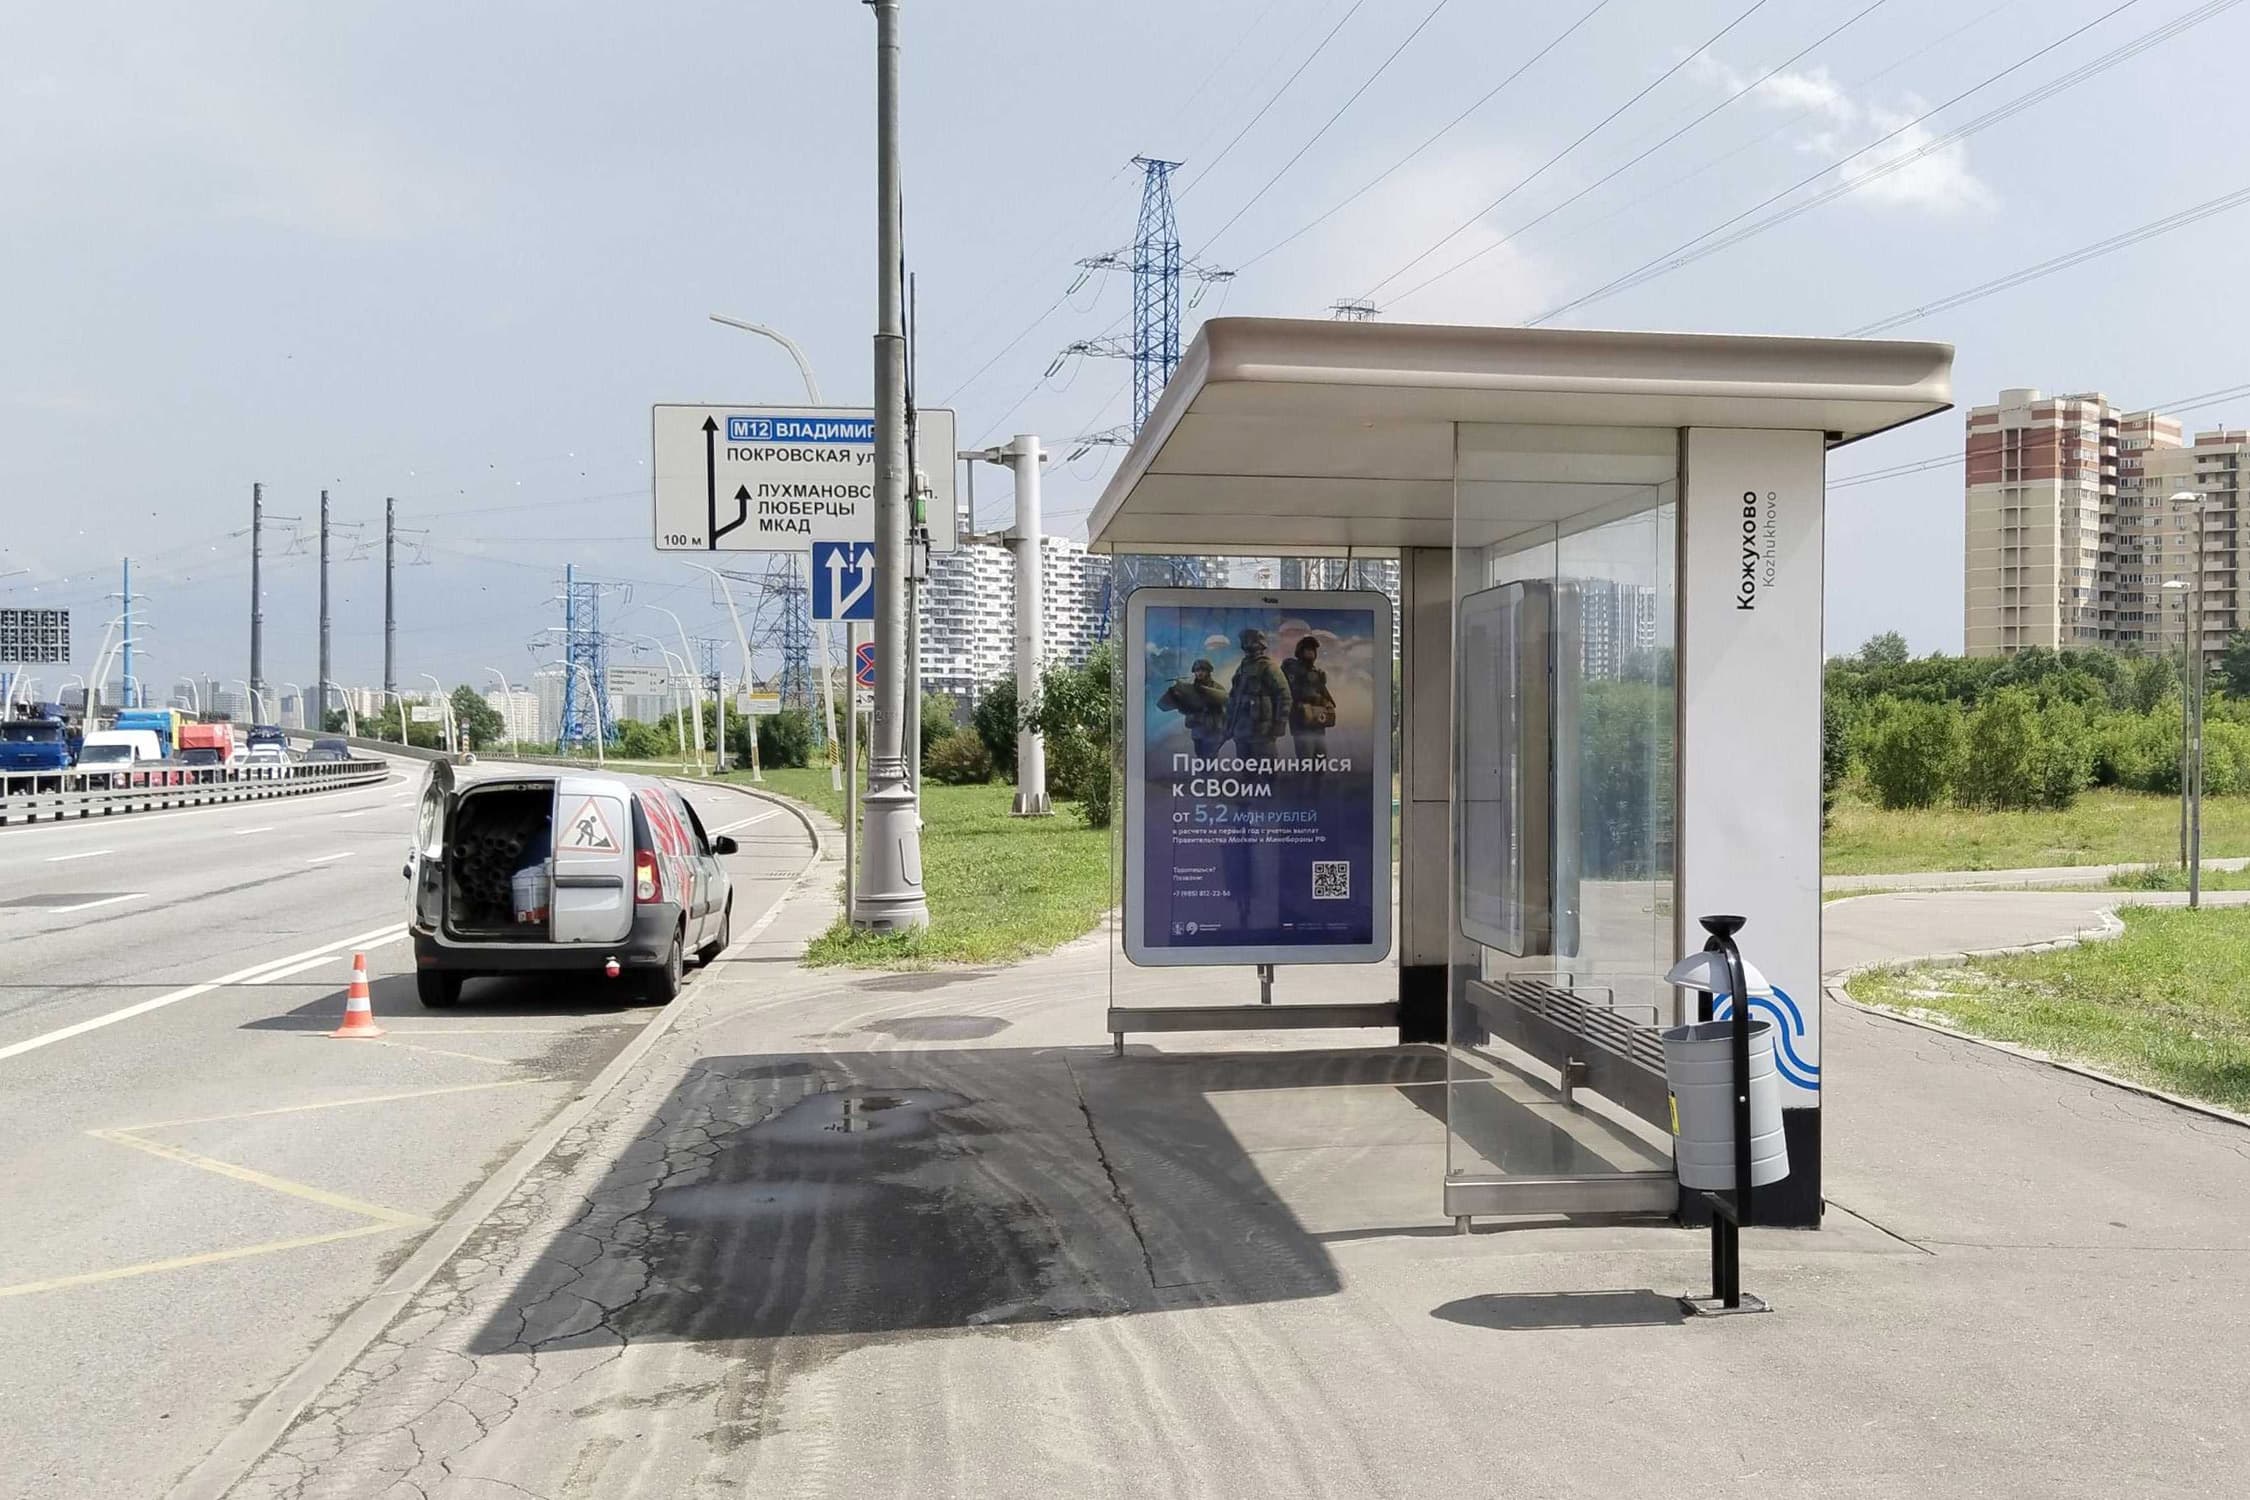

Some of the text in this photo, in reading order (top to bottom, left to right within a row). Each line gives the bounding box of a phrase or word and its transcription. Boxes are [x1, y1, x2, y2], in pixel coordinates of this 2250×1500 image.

[734, 422, 769, 437] М12
[727, 448, 850, 462] ПОКРОВСКАЯ
[757, 484, 875, 499] ЛУХМАНОВС
[757, 502, 855, 517] ЛЮБЕРЦЫ
[759, 519, 811, 534] МКАД
[664, 534, 687, 546] 100
[1763, 491, 1777, 587] Kozhukhovo
[1737, 491, 1760, 610] Кожухово
[1172, 753, 1352, 776] Присоединяйся
[1172, 778, 1272, 797] к СВОим
[1195, 804, 1228, 825] 5,2
[1267, 810, 1317, 823] РУБЛЕЙ
